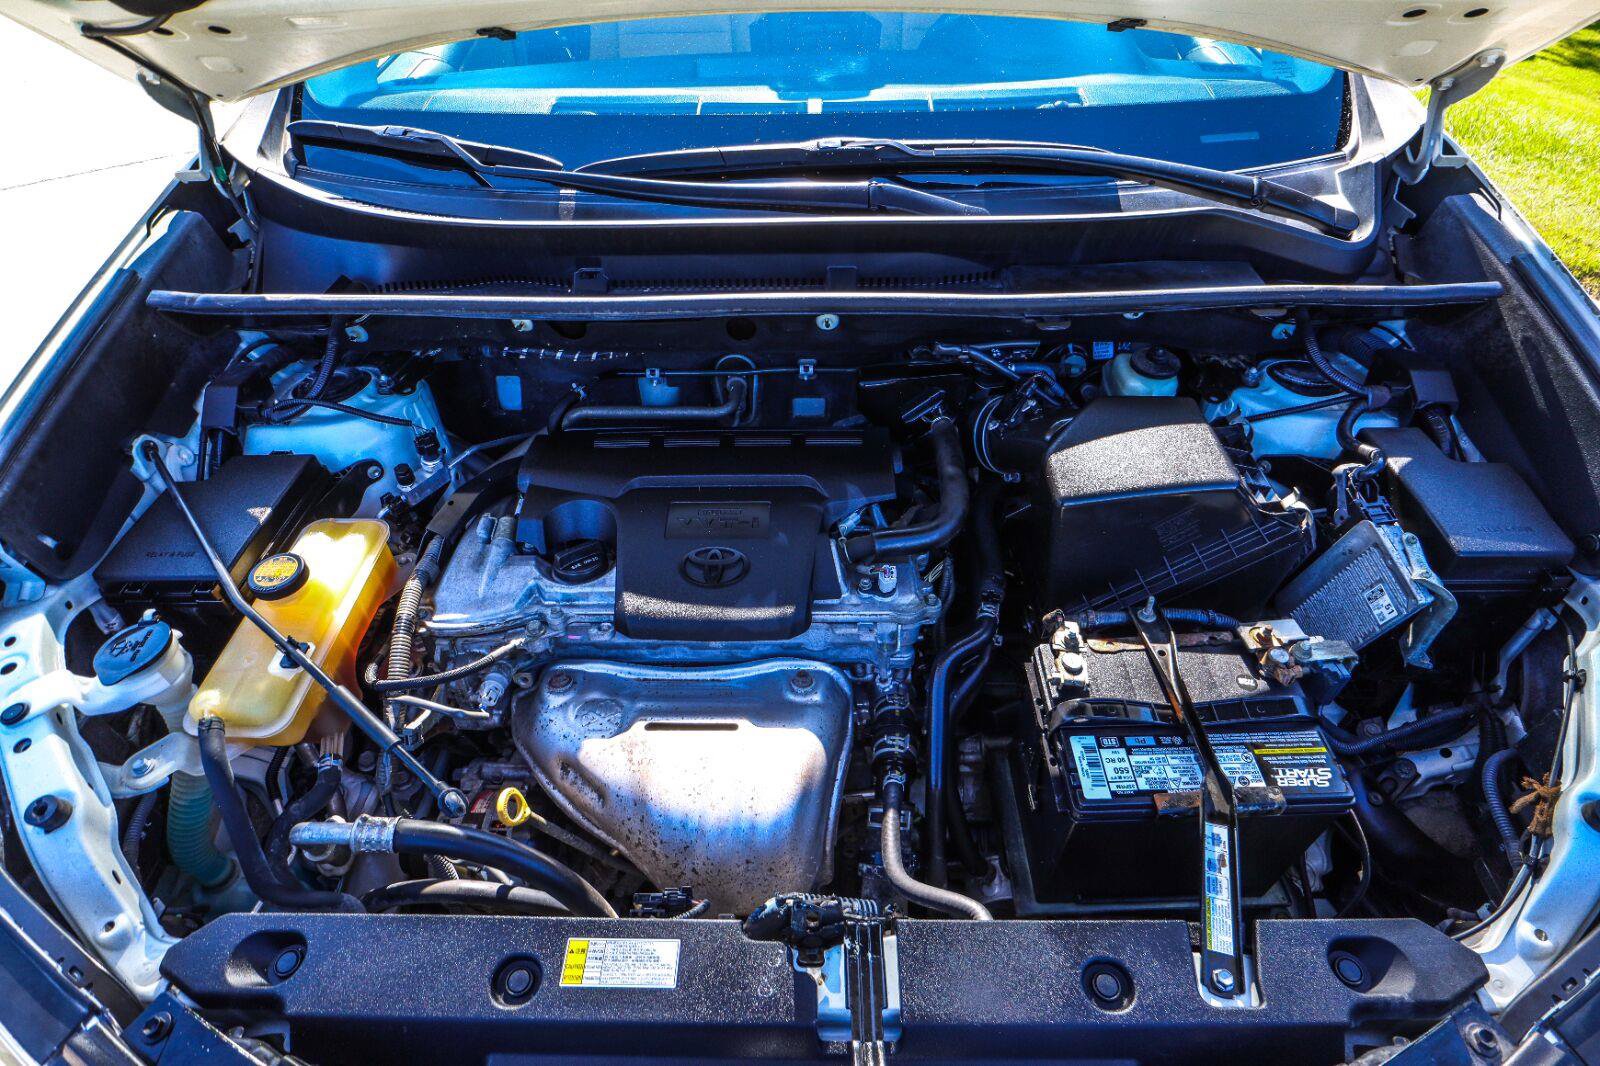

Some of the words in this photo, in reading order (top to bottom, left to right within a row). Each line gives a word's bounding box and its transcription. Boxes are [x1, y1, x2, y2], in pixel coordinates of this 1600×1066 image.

[1113, 766, 1130, 774] 550
[1277, 768, 1332, 778] START
[1277, 777, 1330, 787] SUPER
